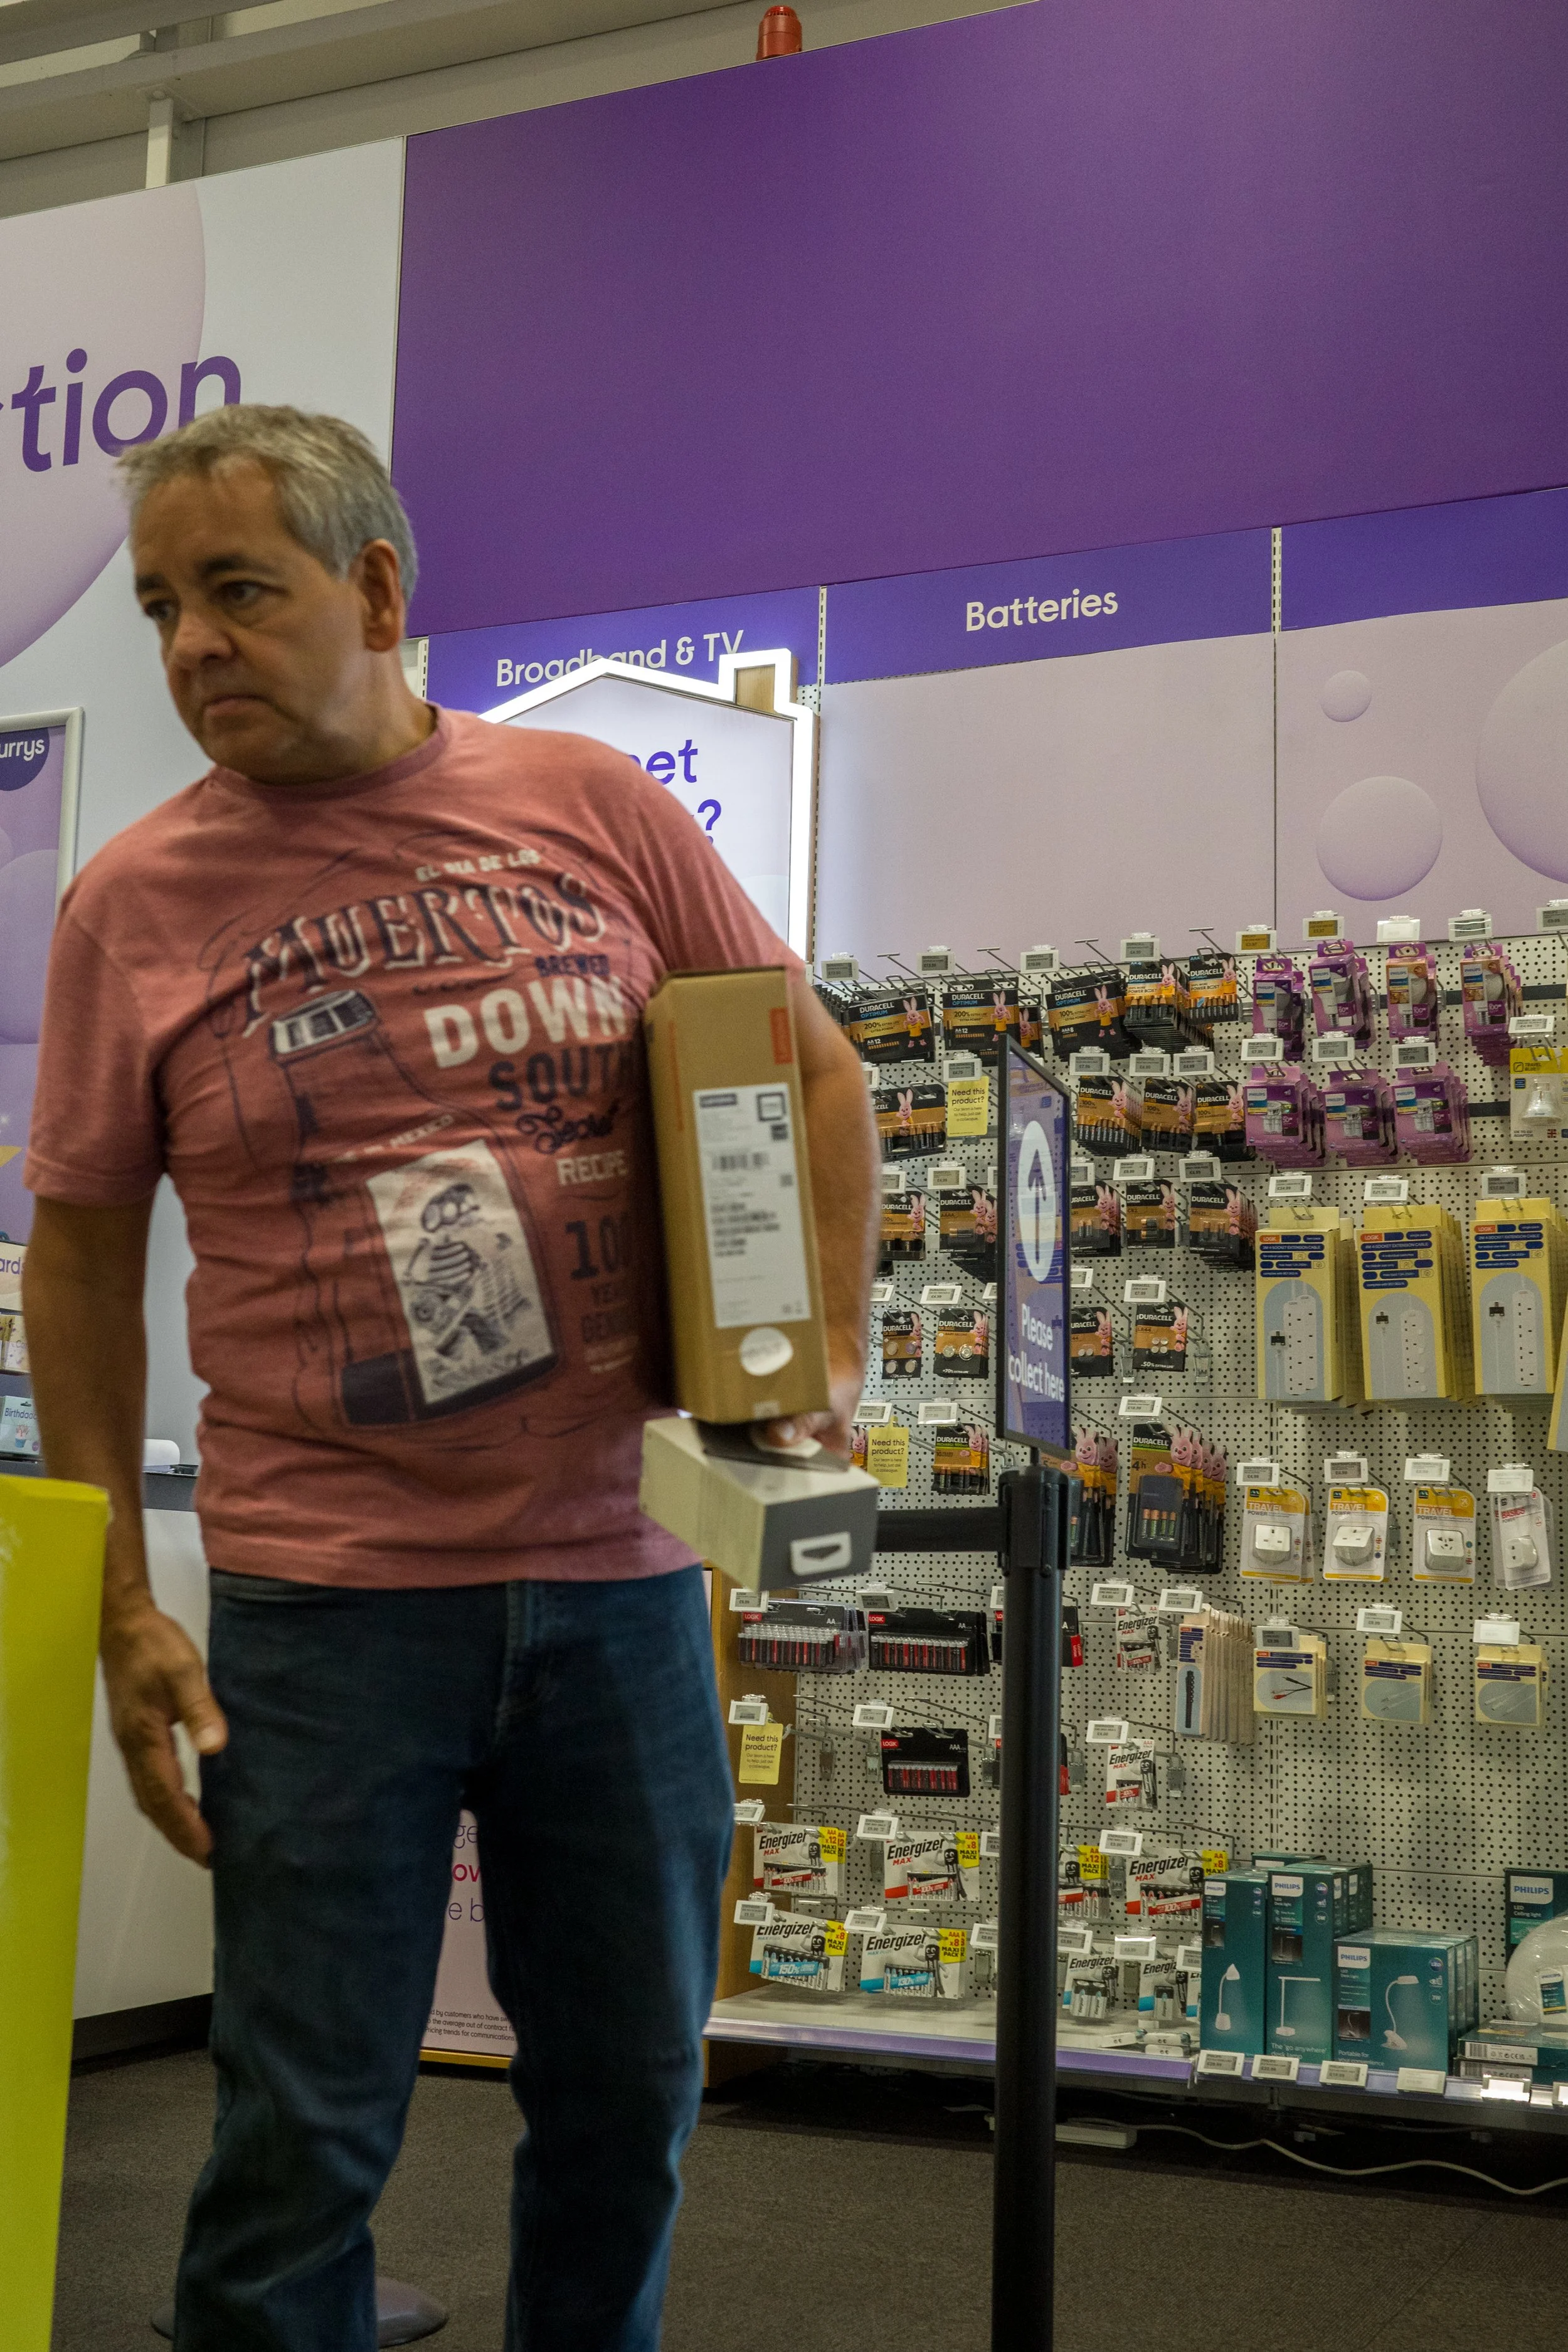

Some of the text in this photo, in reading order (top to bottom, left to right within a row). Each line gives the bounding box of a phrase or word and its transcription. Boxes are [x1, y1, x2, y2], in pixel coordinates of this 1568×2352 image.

[0, 348, 241, 472] tion
[965, 588, 1118, 632] Batteries
[676, 635, 694, 664] &
[703, 630, 744, 655] TV
[1190, 968, 1224, 977] DURACELL
[951, 993, 985, 1001] DURACELL
[1054, 990, 1087, 1001] DURACELL
[1056, 998, 1081, 1006] OPTIMUM
[859, 1002, 895, 1014] DURACELL
[1059, 1009, 1074, 1017] 100%
[861, 1009, 888, 1019] OPTIMUM
[425, 975, 628, 1069] DOWN
[864, 1019, 882, 1029] 200%
[1080, 1087, 1113, 1096] DURACELL
[1145, 1092, 1178, 1101] DURACELL
[951, 1096, 985, 1106] product?
[1197, 1095, 1230, 1103] DURACELL
[1191, 1195, 1225, 1204] DURACELL
[0, 1256, 24, 1275] ard
[1139, 1313, 1173, 1322] DURACELL
[883, 1324, 912, 1332] DURACELL
[1022, 1303, 1053, 1351] Please
[1008, 1350, 1065, 1402] collect here
[893, 1438, 906, 1446] this
[1133, 1437, 1168, 1446] DURACELL
[871, 1448, 904, 1456] product?
[1133, 1461, 1140, 1471] 4
[1248, 1502, 1282, 1512] TRAVEL
[1332, 1502, 1366, 1511] TRAVEL
[1416, 1506, 1453, 1516] TRAVEL
[1501, 1507, 1527, 1520] BASICS
[1117, 1616, 1157, 1631] Energizer
[746, 1734, 778, 1742] Need this
[745, 1744, 778, 1752] product?
[1109, 1750, 1152, 1765] Energizer
[759, 1831, 807, 1850] Energizer
[763, 1848, 779, 1857] MAX
[887, 1839, 945, 1860] Energizer
[893, 1857, 912, 1866] MAX
[1129, 1856, 1189, 1877] Energizer
[1135, 1873, 1155, 1882] MAX
[1513, 1885, 1549, 1895] PHILIPS
[756, 1921, 815, 1941] Energizer
[835, 1932, 845, 1940] x8
[827, 1939, 844, 1947] MAXI
[866, 1933, 926, 1952] Energizer
[949, 1938, 960, 1947] x8
[1069, 1956, 1115, 1969] Energizer
[1340, 1954, 1368, 1962] PHILIPS
[779, 1963, 800, 1975] 150%
[1143, 1962, 1177, 1974] Energiz
[435, 2009, 443, 2017] by
[444, 2010, 472, 2020] customers
[472, 2012, 485, 2020] who
[485, 2013, 500, 2021] have
[442, 2020, 465, 2029] average
[484, 2023, 509, 2032] contract
[443, 2028, 460, 2037] trends
[461, 2029, 470, 2037] for
[470, 2030, 515, 2042] communications
[1338, 2049, 1363, 2057] Portable
